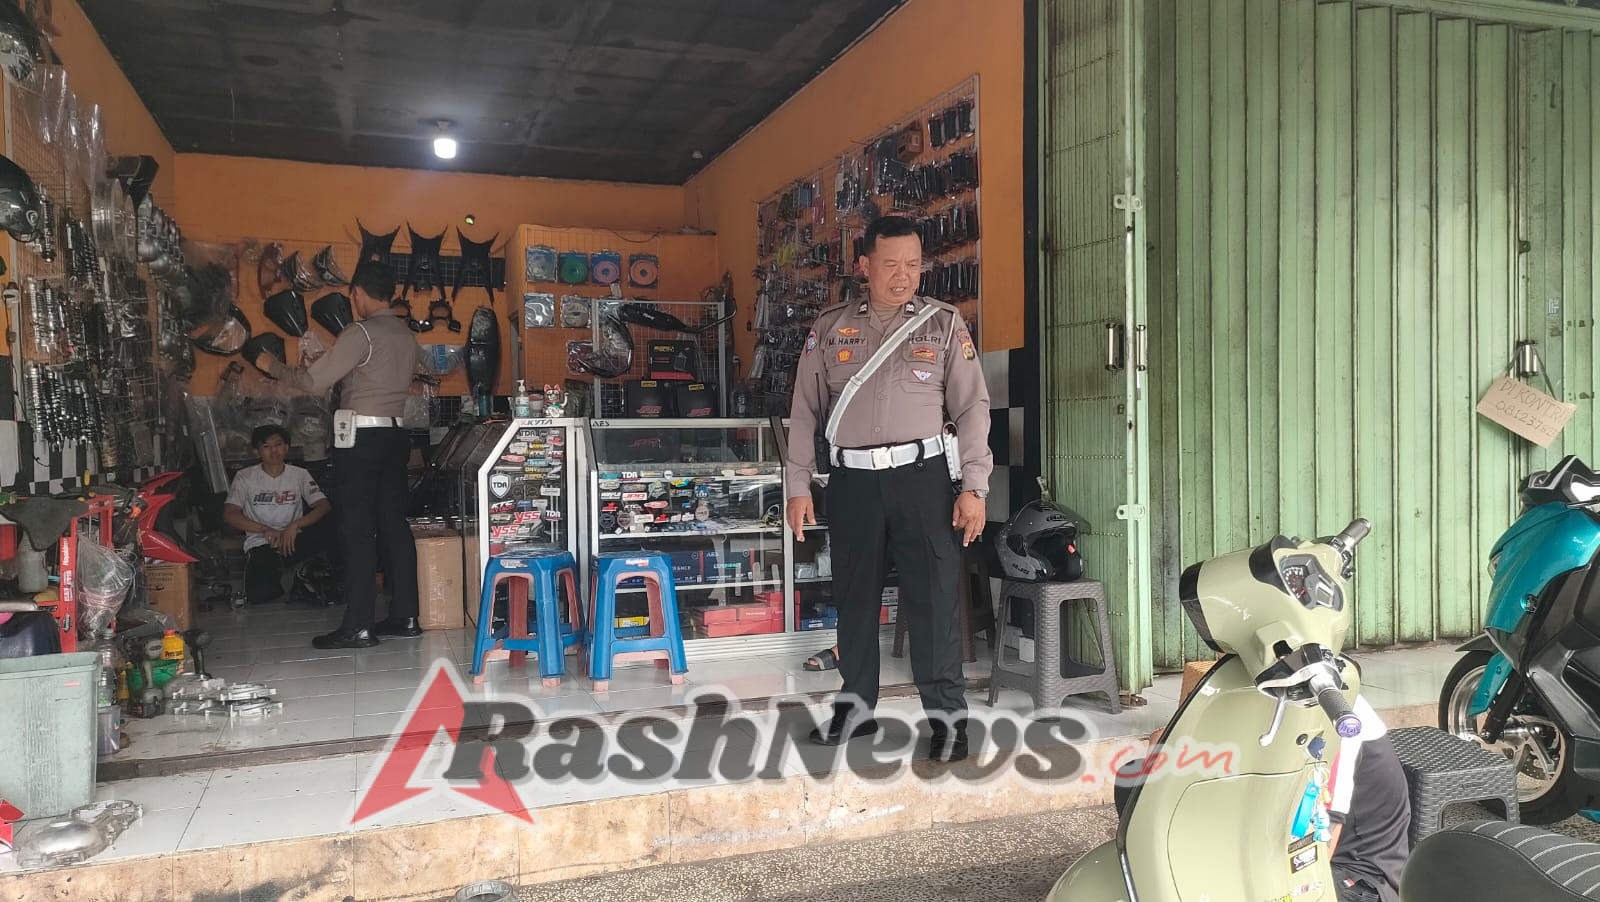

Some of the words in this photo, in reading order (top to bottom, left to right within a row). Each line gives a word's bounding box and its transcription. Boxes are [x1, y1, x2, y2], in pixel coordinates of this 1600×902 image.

[839, 337, 866, 345] HARRY
[513, 511, 541, 524] YSS
[491, 525, 519, 538] YSS
